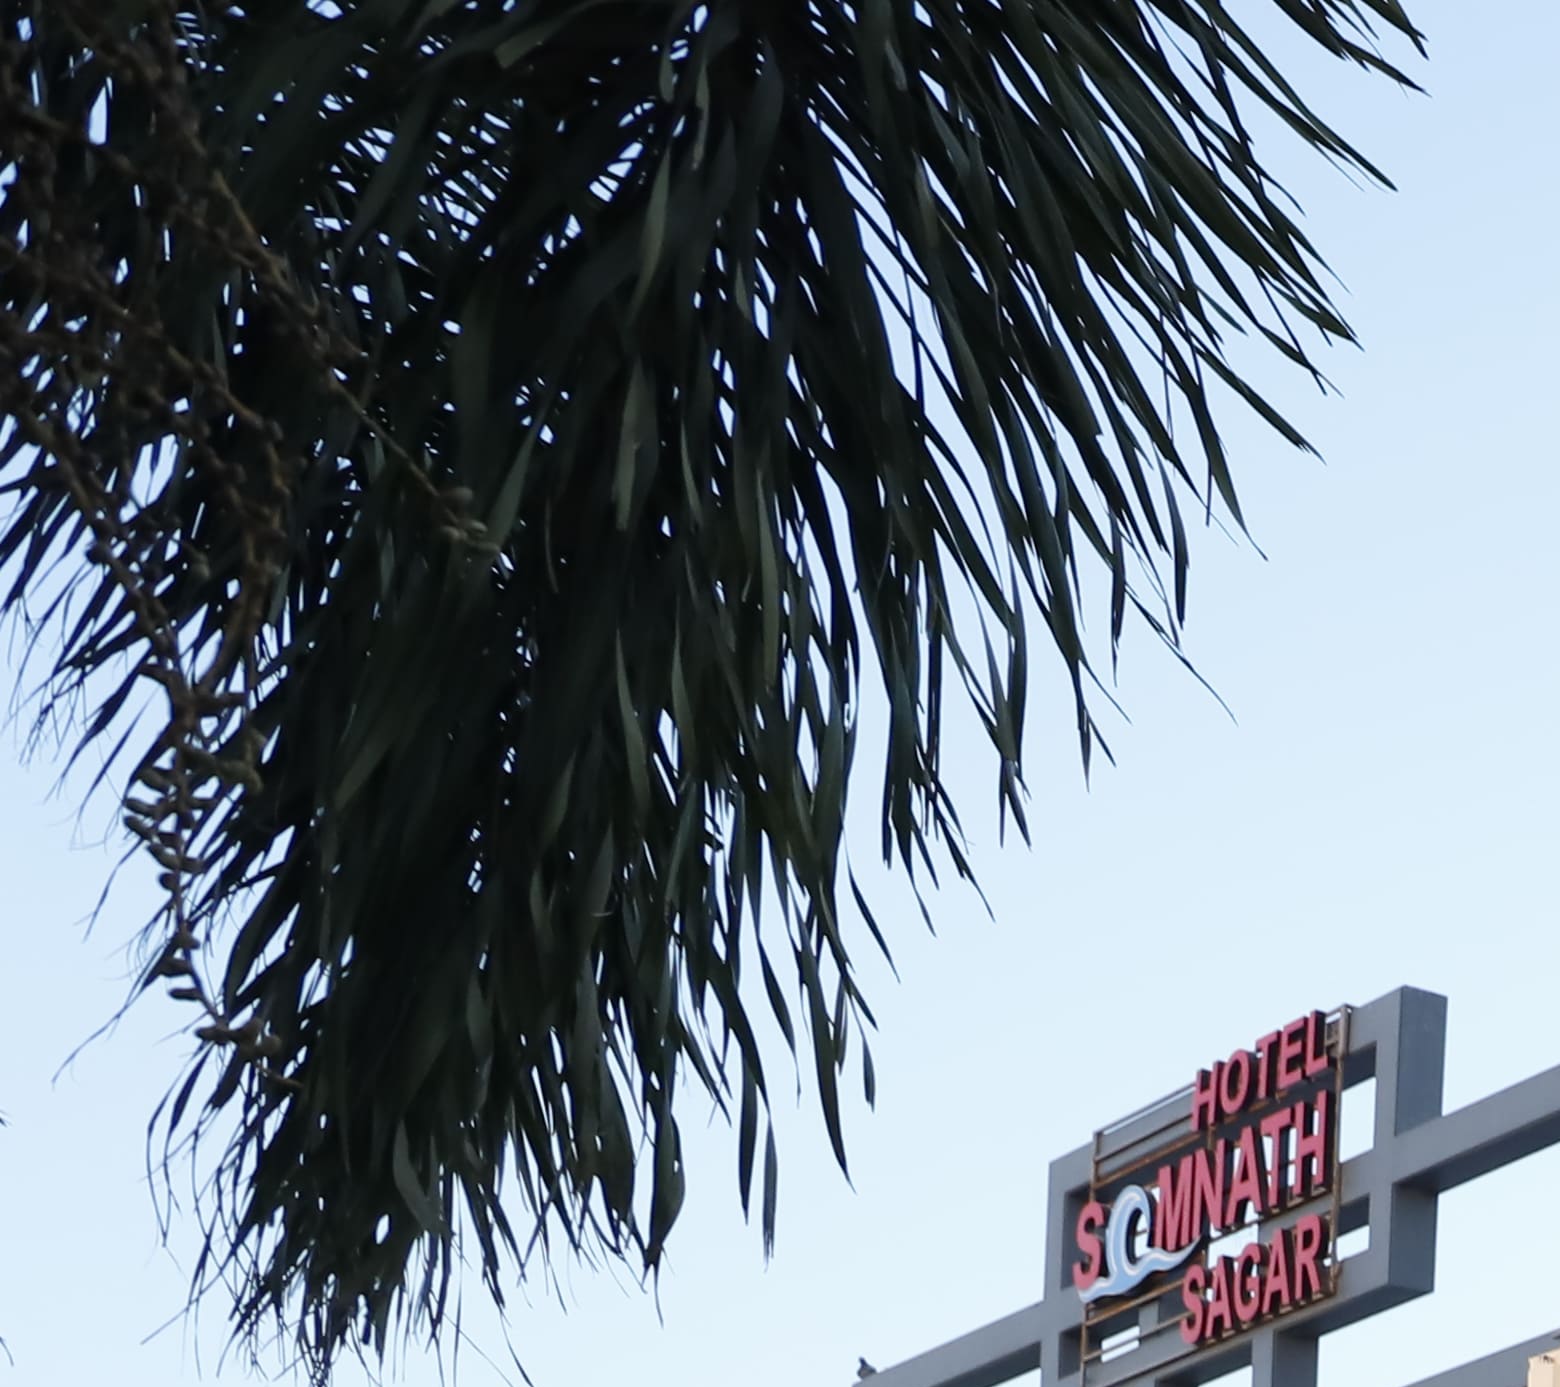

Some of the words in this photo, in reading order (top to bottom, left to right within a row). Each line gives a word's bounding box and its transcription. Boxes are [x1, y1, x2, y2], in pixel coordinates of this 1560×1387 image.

[1190, 1009, 1328, 1132] HOTEL
[1072, 1089, 1332, 1302] SOMNATH
[1180, 1214, 1325, 1344] SAGAR
